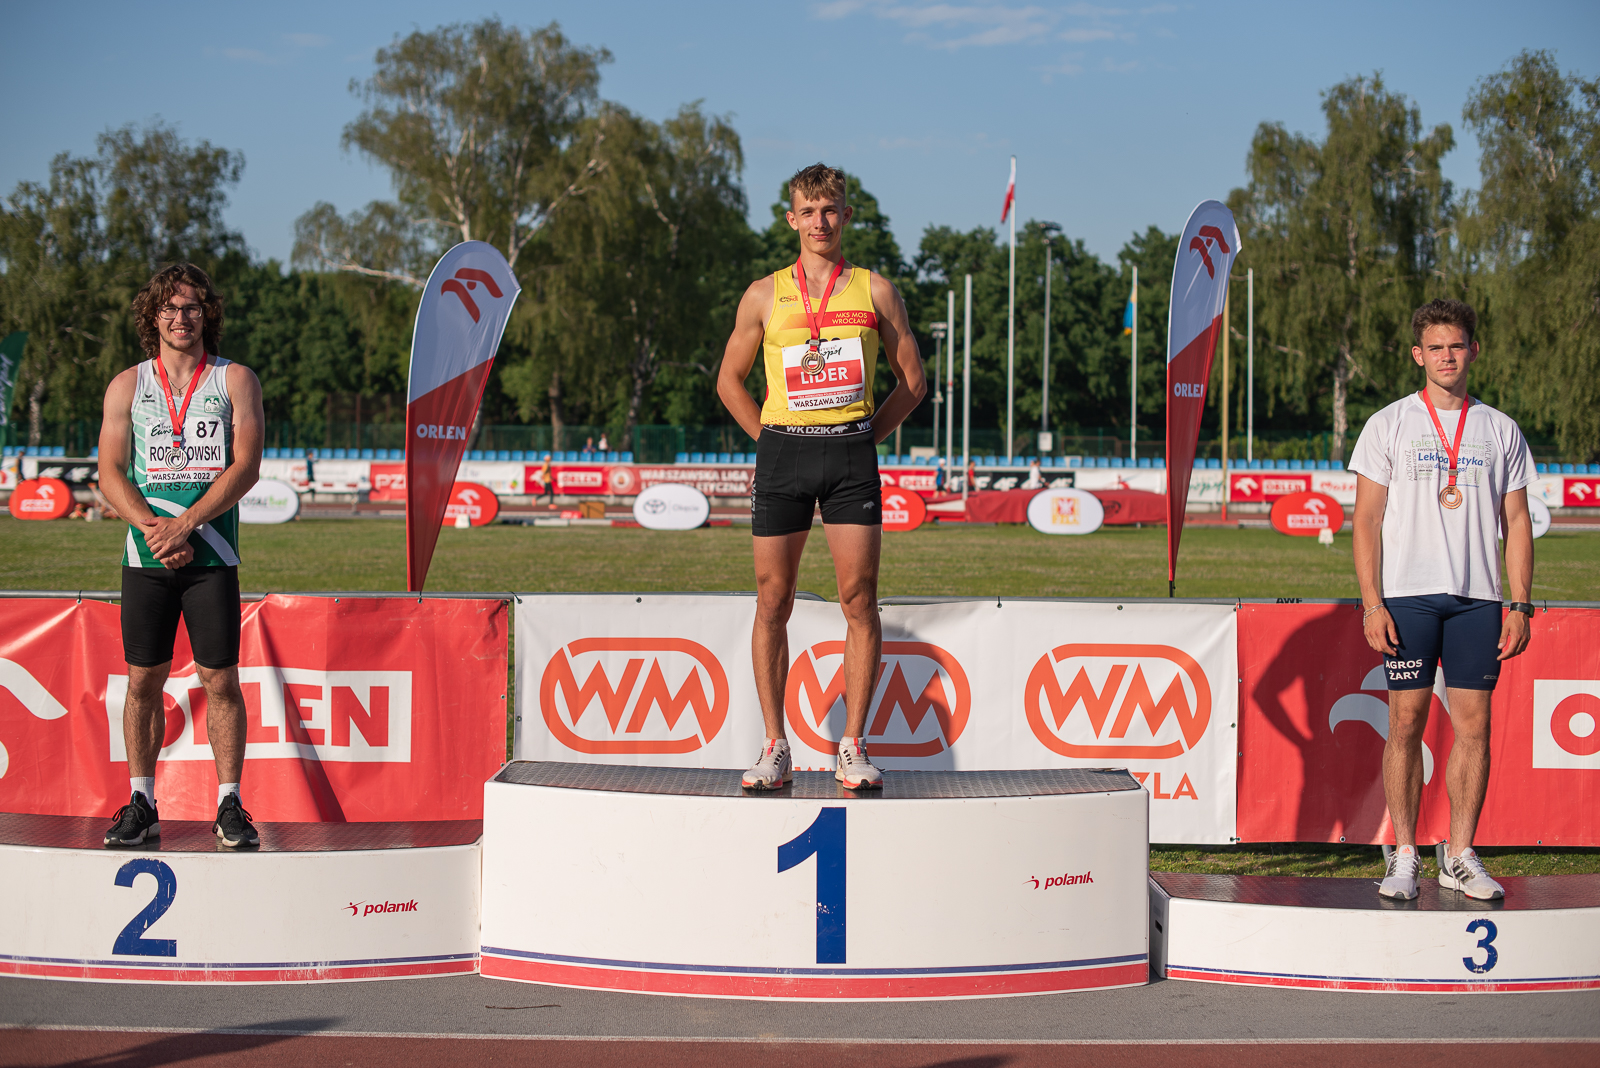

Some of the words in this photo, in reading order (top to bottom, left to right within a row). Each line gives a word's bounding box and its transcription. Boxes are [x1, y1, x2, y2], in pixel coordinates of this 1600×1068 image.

[801, 366, 849, 385] LIDER
[793, 397, 834, 408] WARSZAWA
[835, 395, 853, 404] 2022
[196, 421, 219, 438] 87
[416, 424, 466, 440] ORLEN
[805, 426, 832, 435] DZIK
[151, 472, 191, 480] WARSZAWA
[193, 472, 211, 480] 2022
[640, 469, 720, 480] WARSZAWSKA
[722, 470, 749, 482] LIGA
[1385, 659, 1423, 670] AGROS
[1388, 670, 1420, 681] ŻARY
[777, 807, 847, 964] 1
[1043, 870, 1094, 891] polanik
[112, 858, 178, 957] 2
[362, 899, 419, 918] polanik
[1462, 918, 1499, 974] 3
